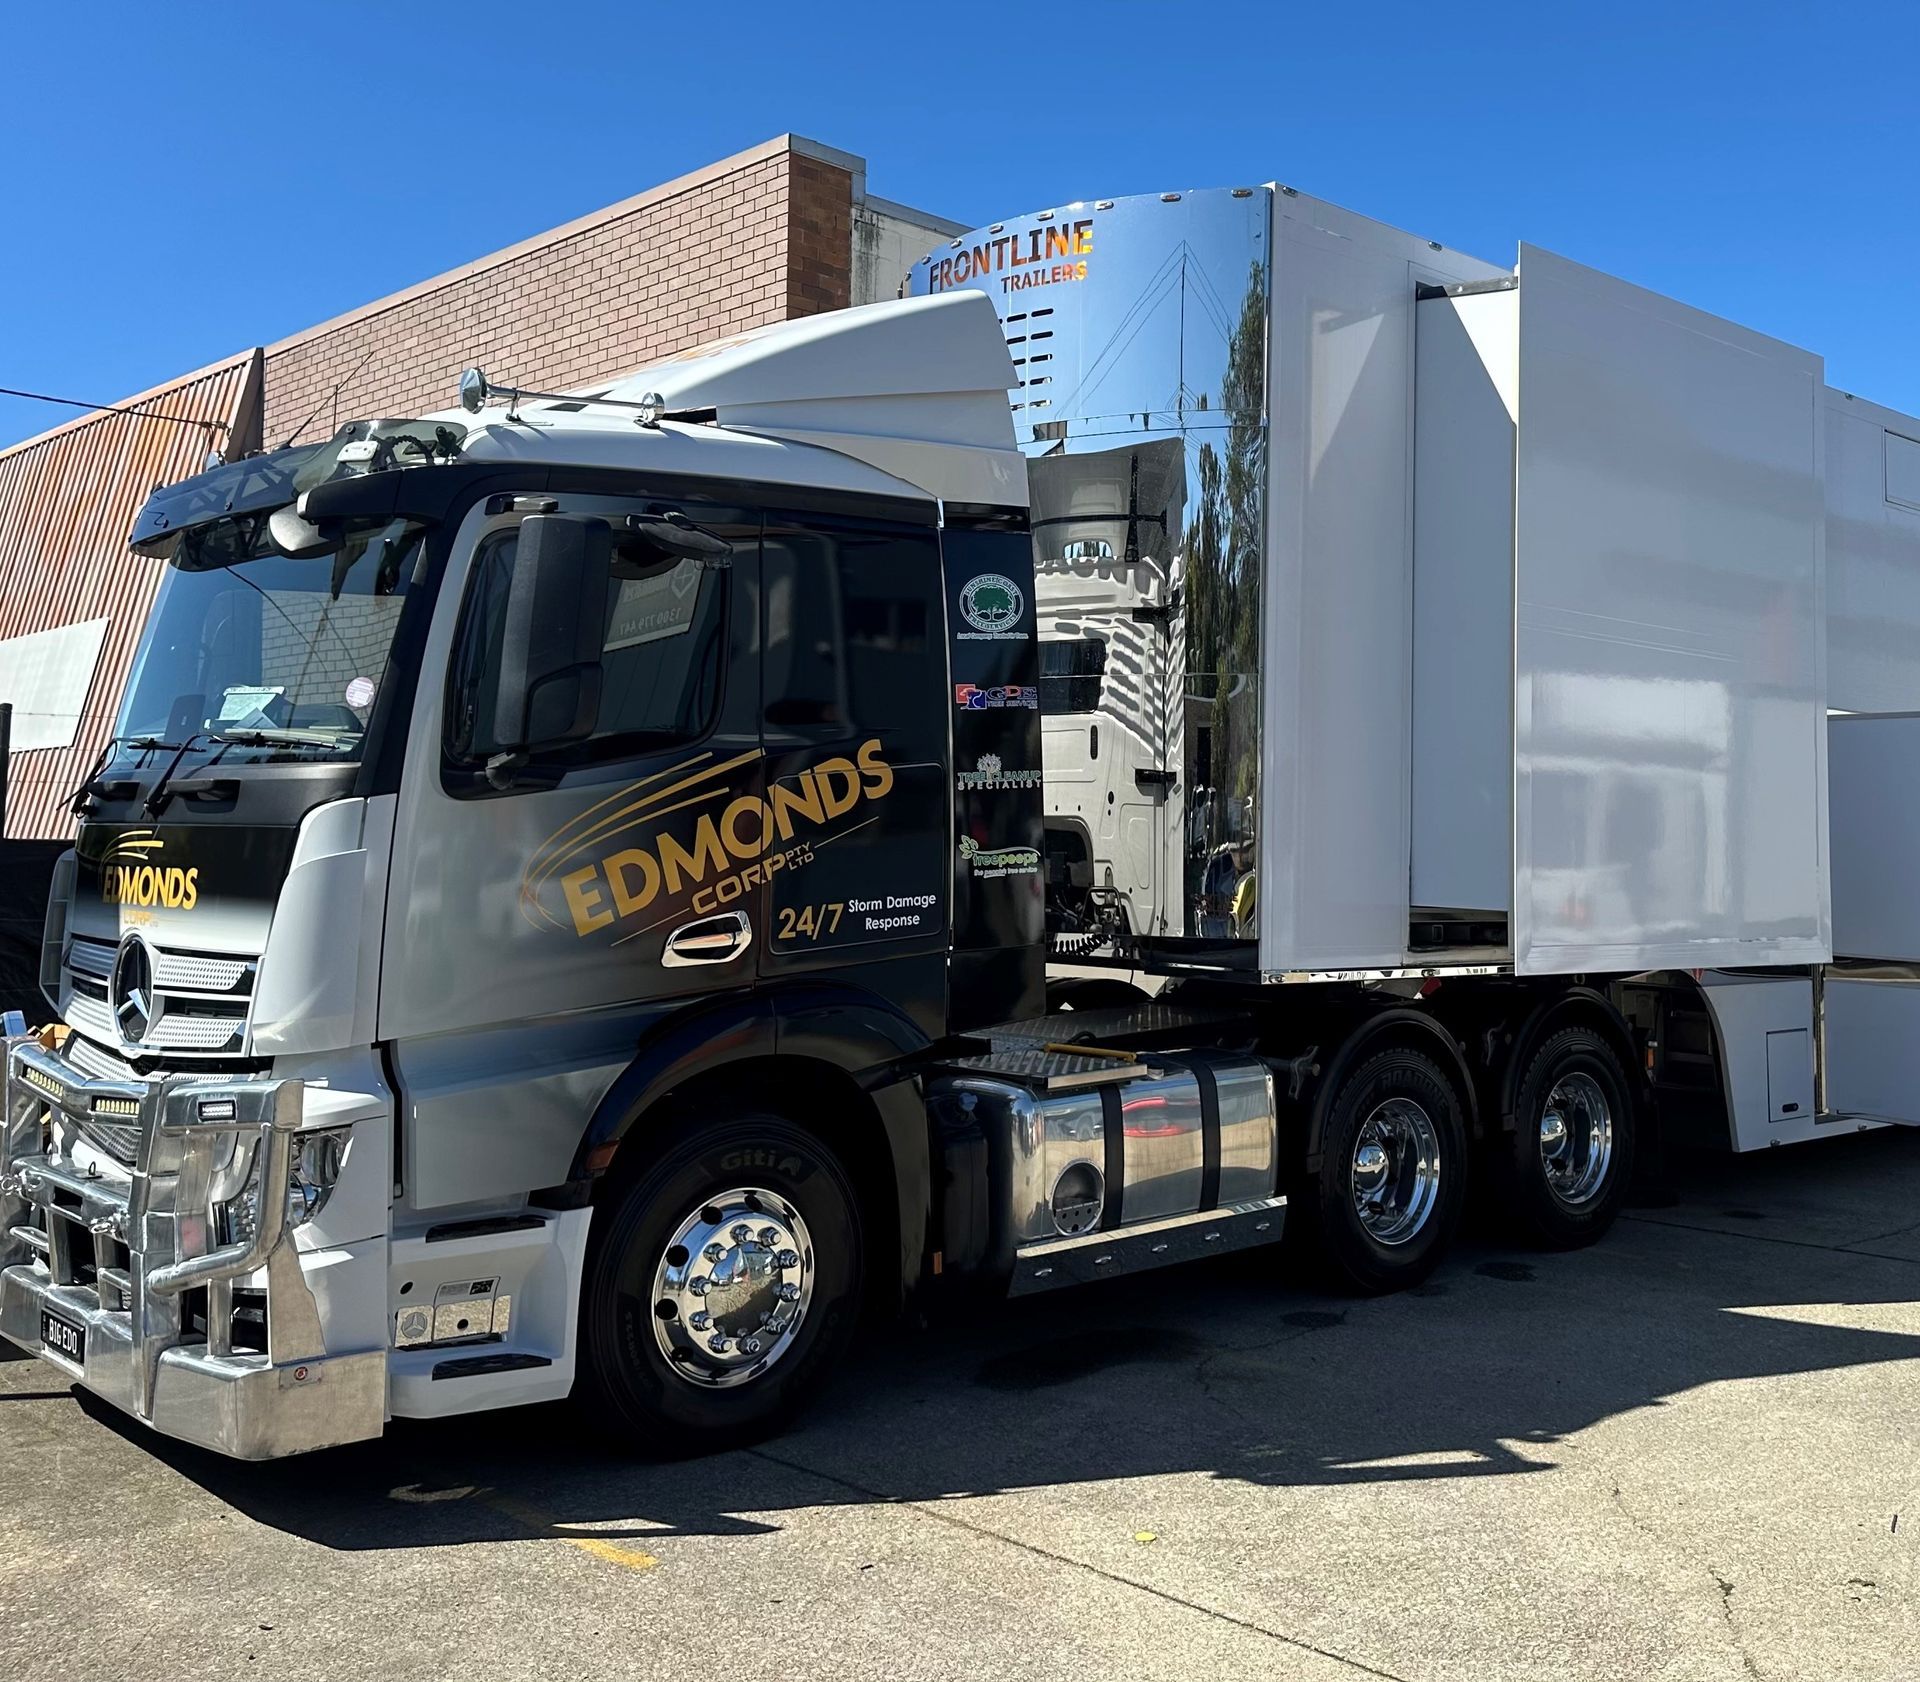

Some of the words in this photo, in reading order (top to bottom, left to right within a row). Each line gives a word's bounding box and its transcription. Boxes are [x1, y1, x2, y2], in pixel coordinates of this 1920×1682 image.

[930, 219, 1093, 294] FRONTLINE
[1001, 260, 1088, 293] TRAILERS
[957, 772, 986, 781] TREE
[991, 770, 1041, 781] CLEANUP
[957, 780, 1041, 790] SPECIALIST
[561, 738, 894, 937] EDMONDS
[785, 841, 810, 860] PTY
[789, 852, 814, 870] LTD
[102, 866, 199, 910] EDMONDS
[691, 853, 786, 914] CORP
[778, 903, 844, 941] 24/7
[848, 898, 883, 913] Storm
[886, 894, 937, 910] Damage
[865, 914, 921, 932] Response
